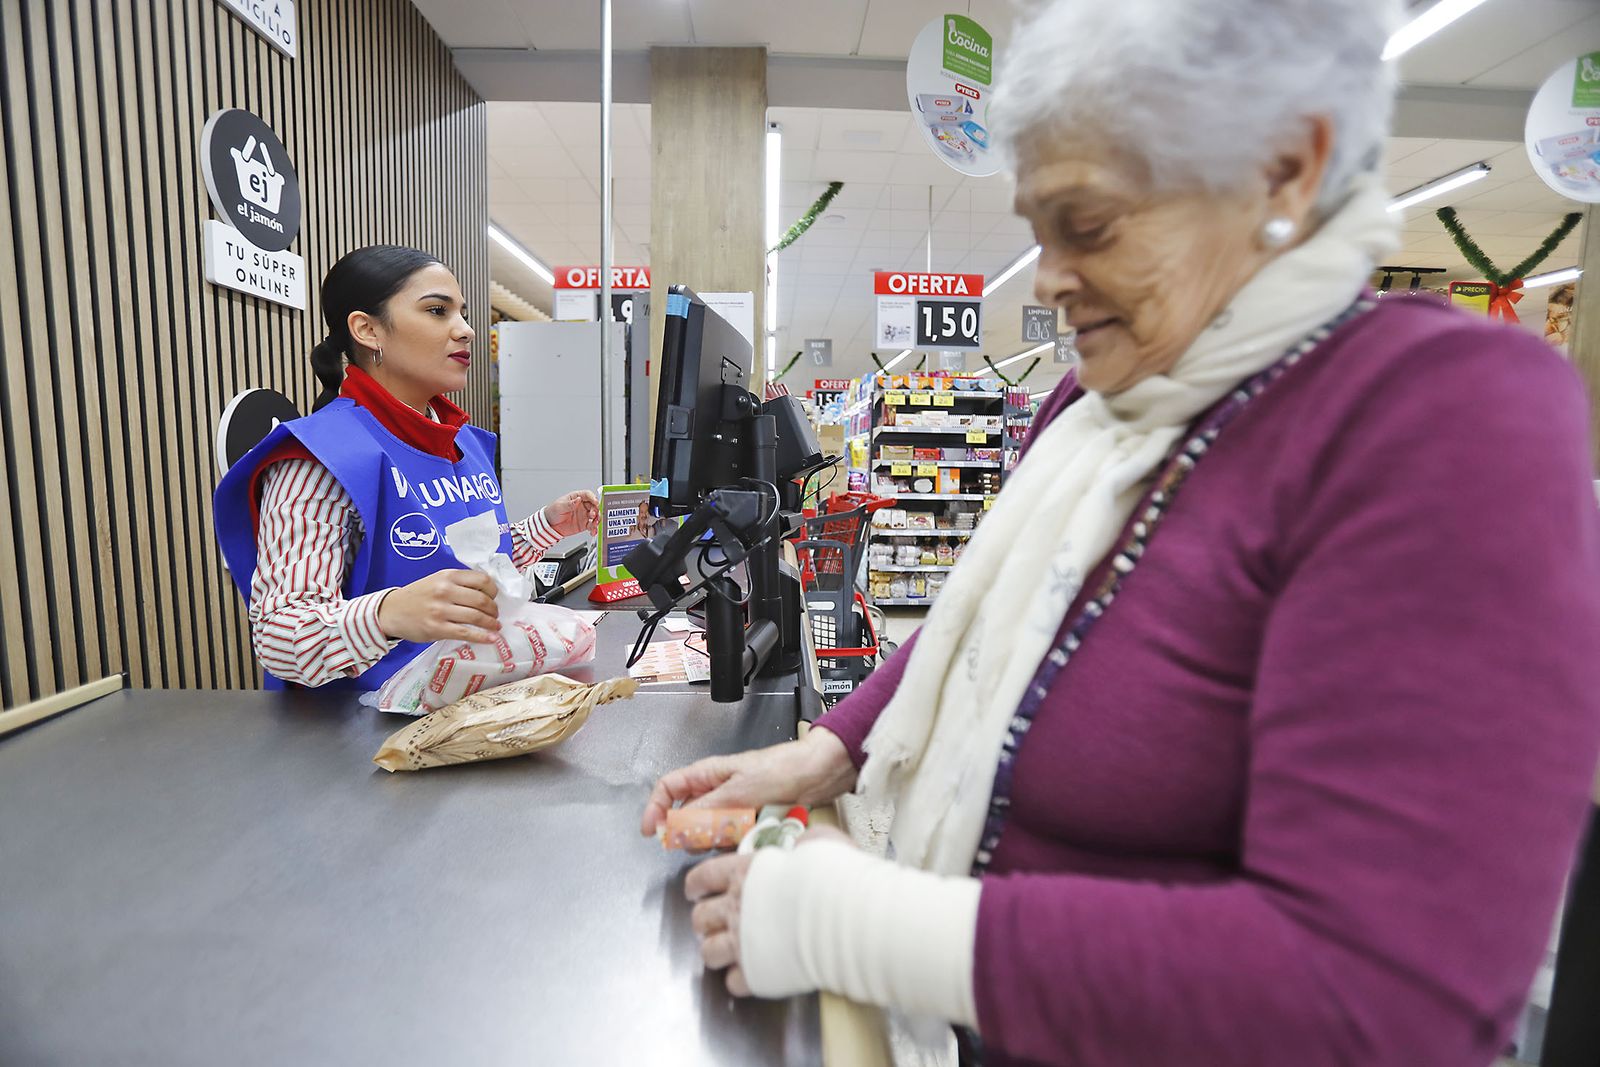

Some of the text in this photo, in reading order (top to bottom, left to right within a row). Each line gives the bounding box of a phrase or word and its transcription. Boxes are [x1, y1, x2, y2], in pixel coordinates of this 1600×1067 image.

[240, 0, 291, 45] ICILIO
[948, 29, 989, 58] Cocina
[957, 85, 978, 98] PYREX
[249, 171, 268, 203] ej
[237, 203, 284, 234] el jamón
[225, 241, 296, 280] TU SÚPER
[236, 268, 290, 298] ONLINE
[567, 268, 650, 287] OFRTA
[888, 274, 969, 294] OFERTA
[820, 380, 849, 389] OFERT
[608, 508, 636, 517] ALIMENTA
[608, 517, 636, 527] UNA VIDA
[608, 527, 628, 537] MEJOR
[824, 682, 851, 690] jamón
